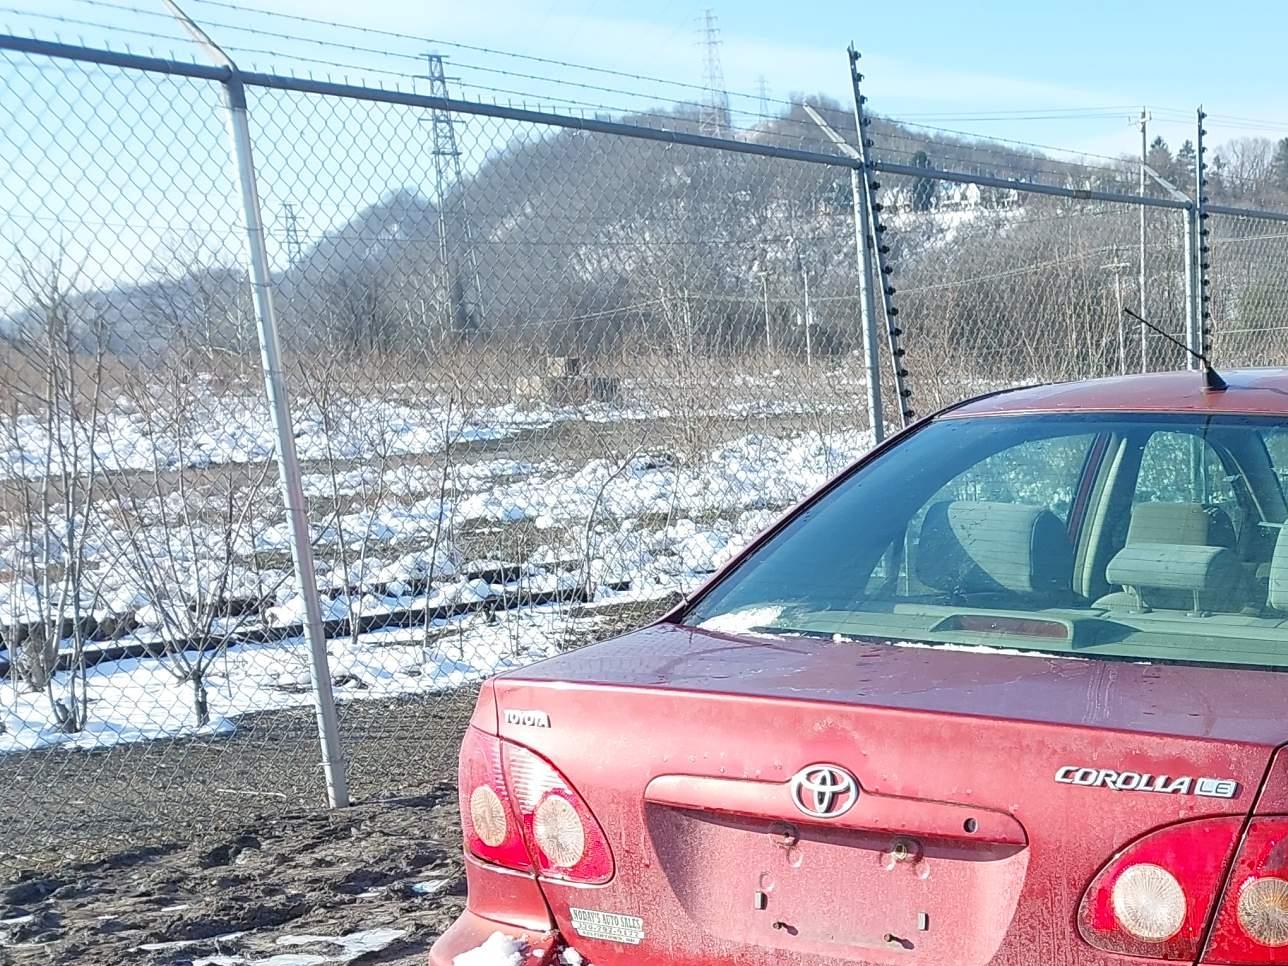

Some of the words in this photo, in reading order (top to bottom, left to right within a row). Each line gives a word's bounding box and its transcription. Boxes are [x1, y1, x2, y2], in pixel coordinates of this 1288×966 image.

[1054, 766, 1194, 795] COROLLA
[1198, 780, 1234, 796] LE
[602, 913, 619, 926] AUTO
[621, 916, 641, 929] SALES
